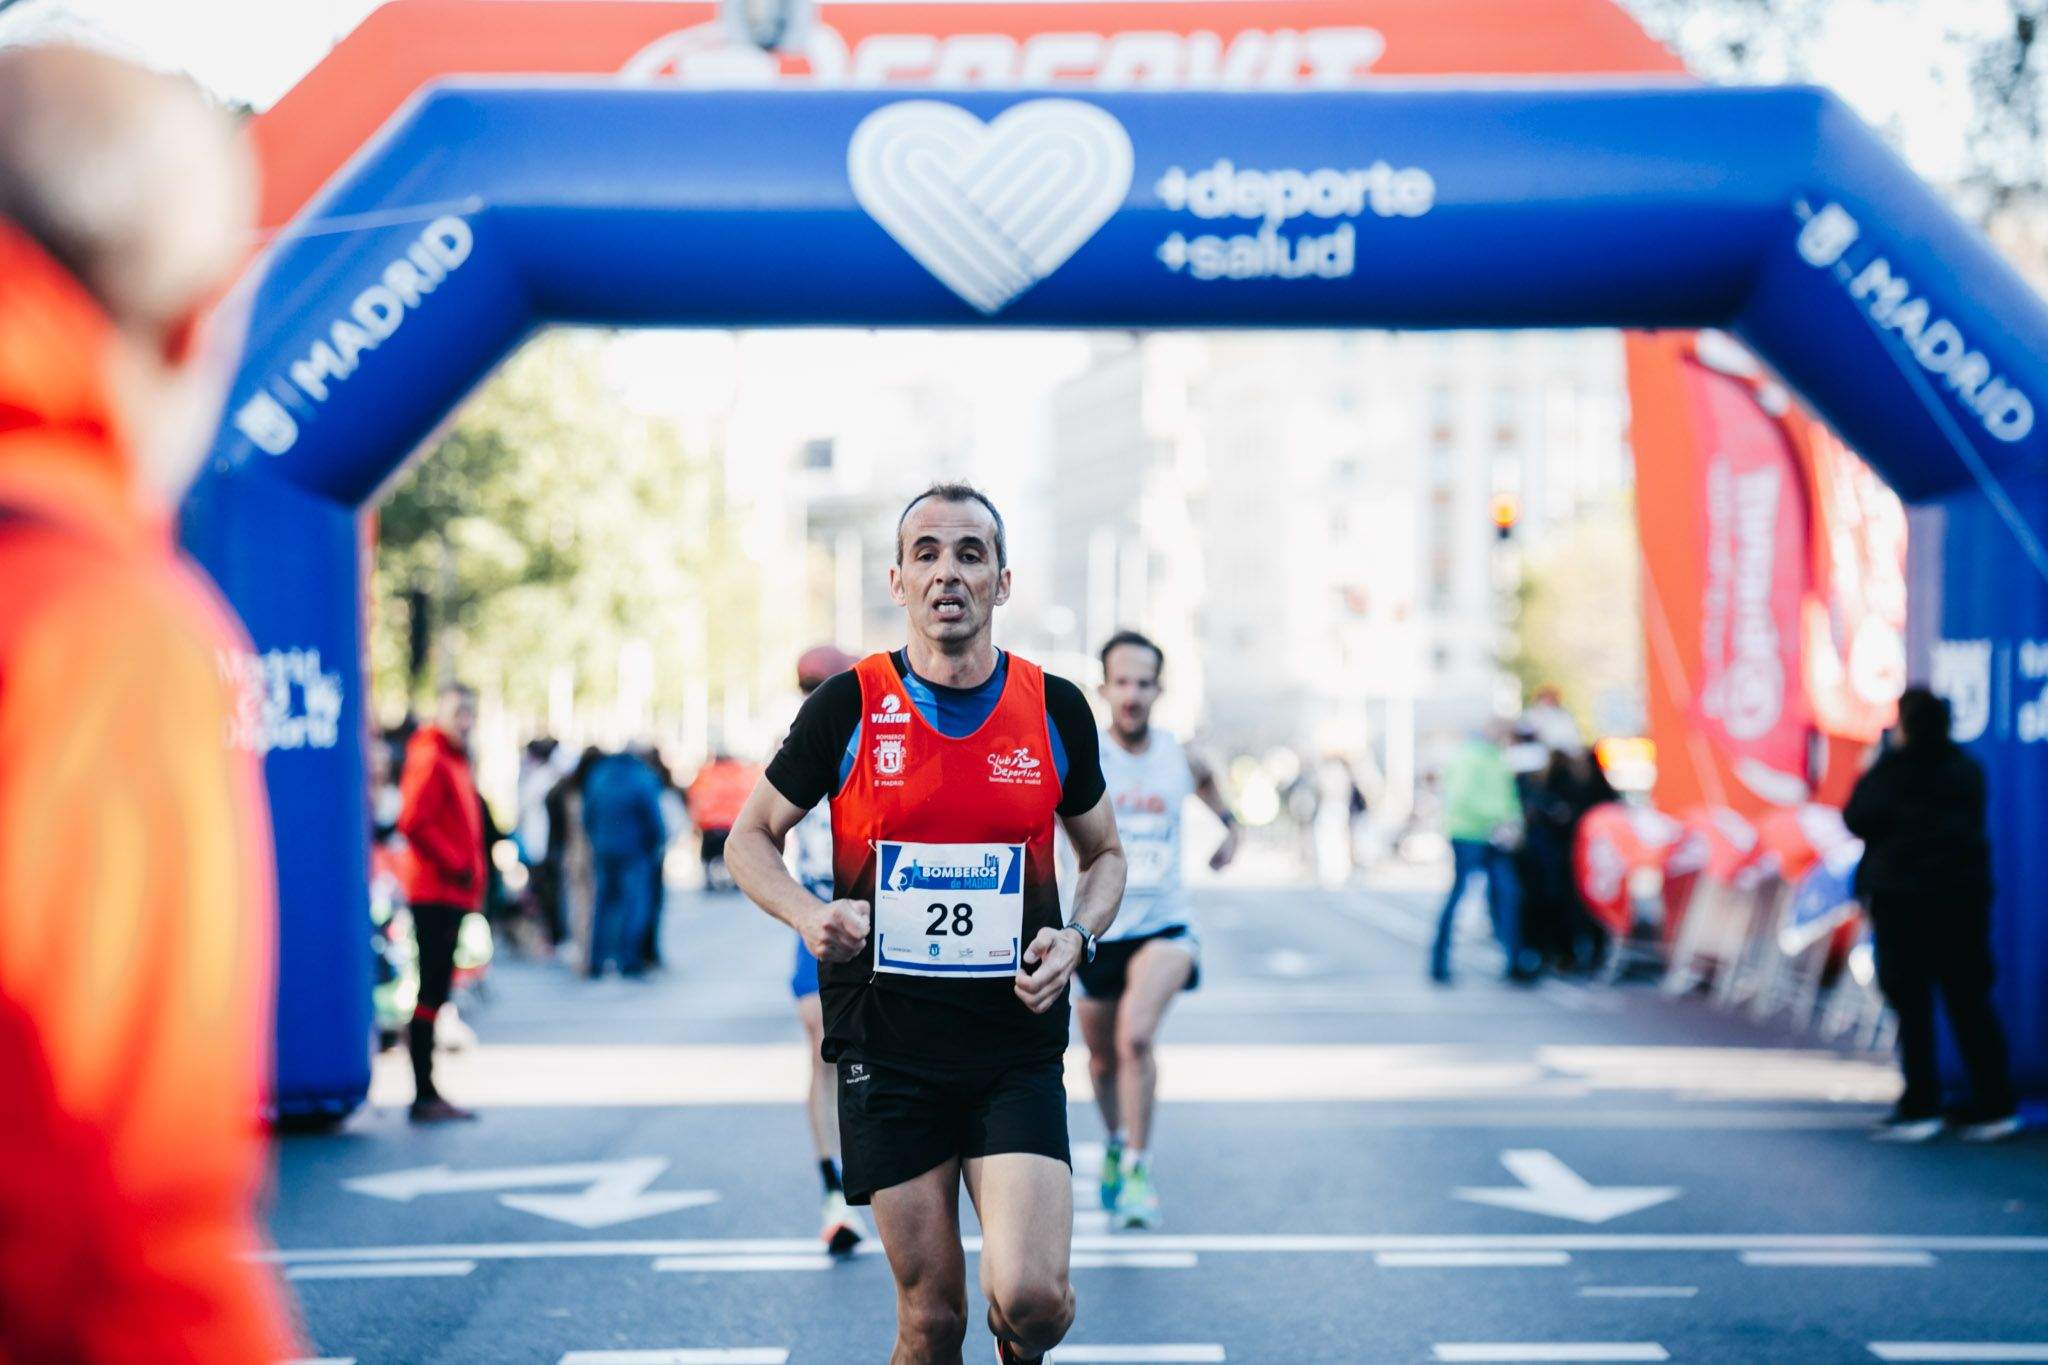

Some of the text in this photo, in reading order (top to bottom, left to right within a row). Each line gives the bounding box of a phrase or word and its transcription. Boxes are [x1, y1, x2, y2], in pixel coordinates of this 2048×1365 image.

[1153, 158, 1436, 234] +deporte
[1156, 221, 1356, 280] +salud
[290, 214, 475, 402] MADRID
[1850, 256, 2036, 442] MADRID
[871, 712, 912, 724] VIATOR
[921, 865, 998, 879] BOMBEROS
[925, 902, 974, 937] 28
